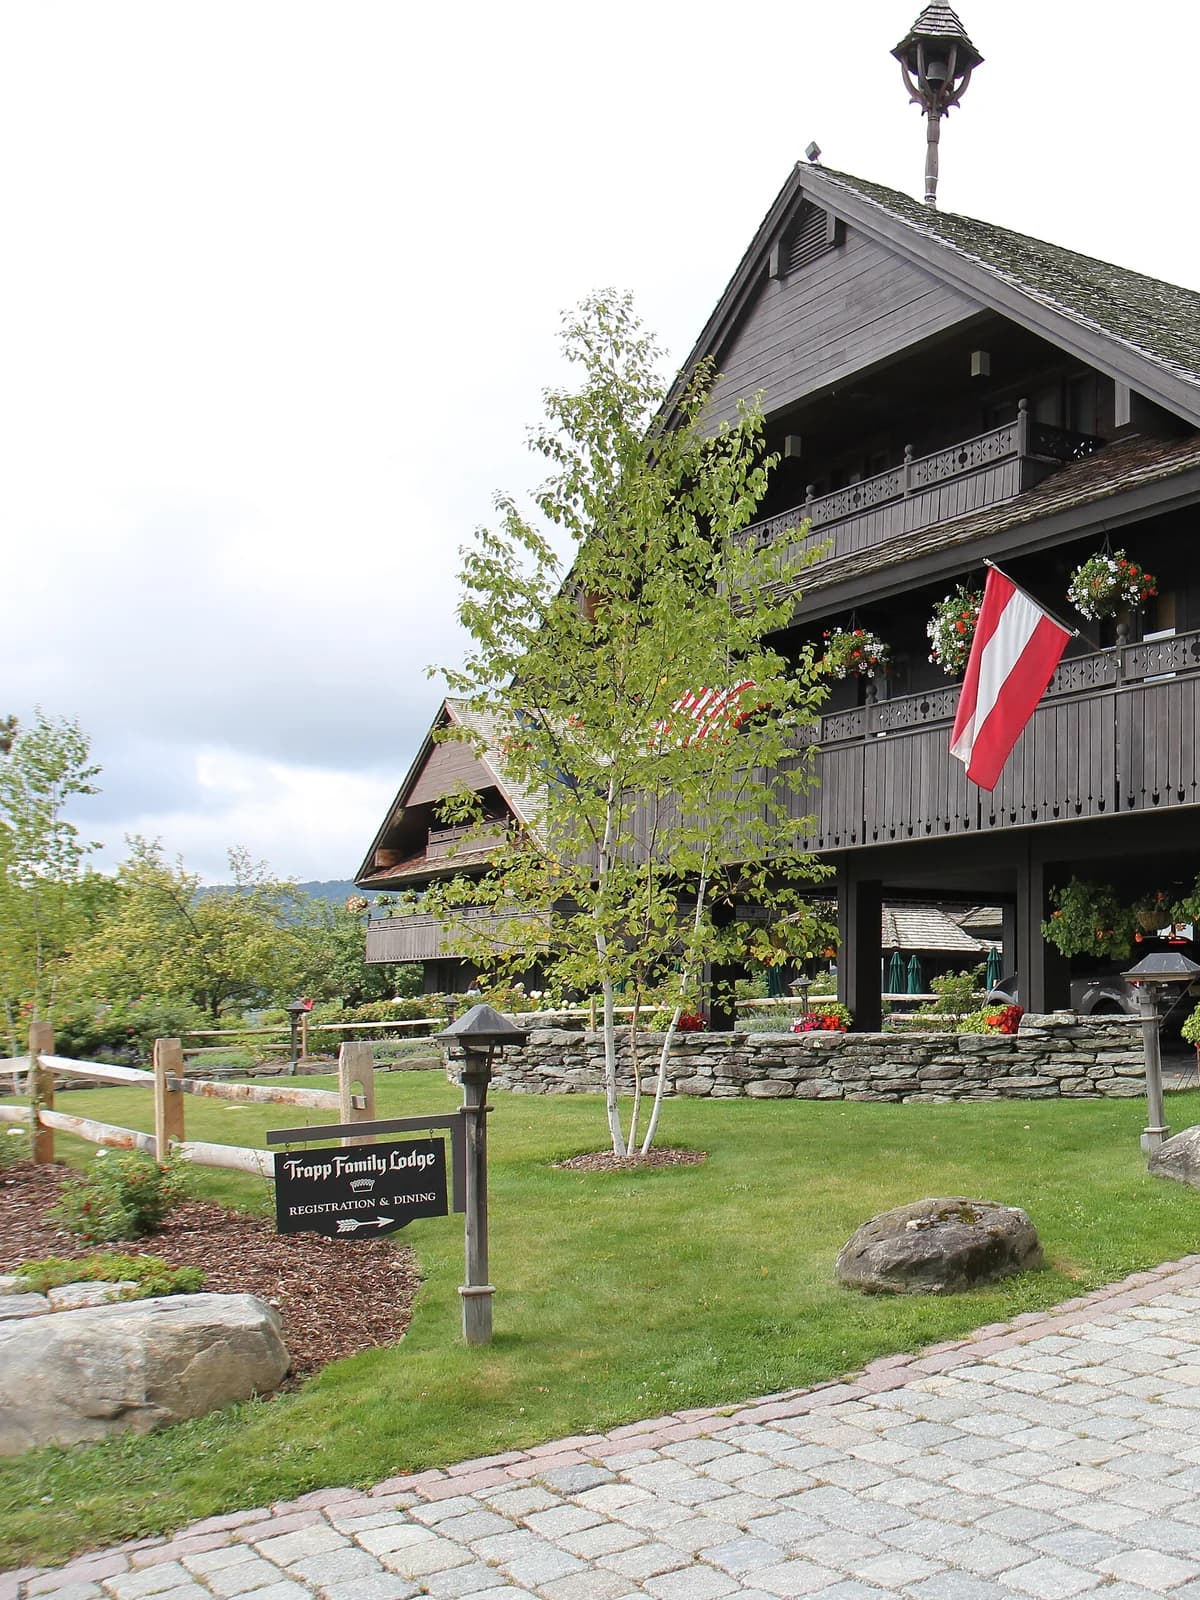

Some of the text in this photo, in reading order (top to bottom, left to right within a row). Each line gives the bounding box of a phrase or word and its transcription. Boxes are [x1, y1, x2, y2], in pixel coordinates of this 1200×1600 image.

[283, 1149, 436, 1181] Trapp Family Lodge
[289, 1192, 437, 1216] REGISTRATION & DINING
